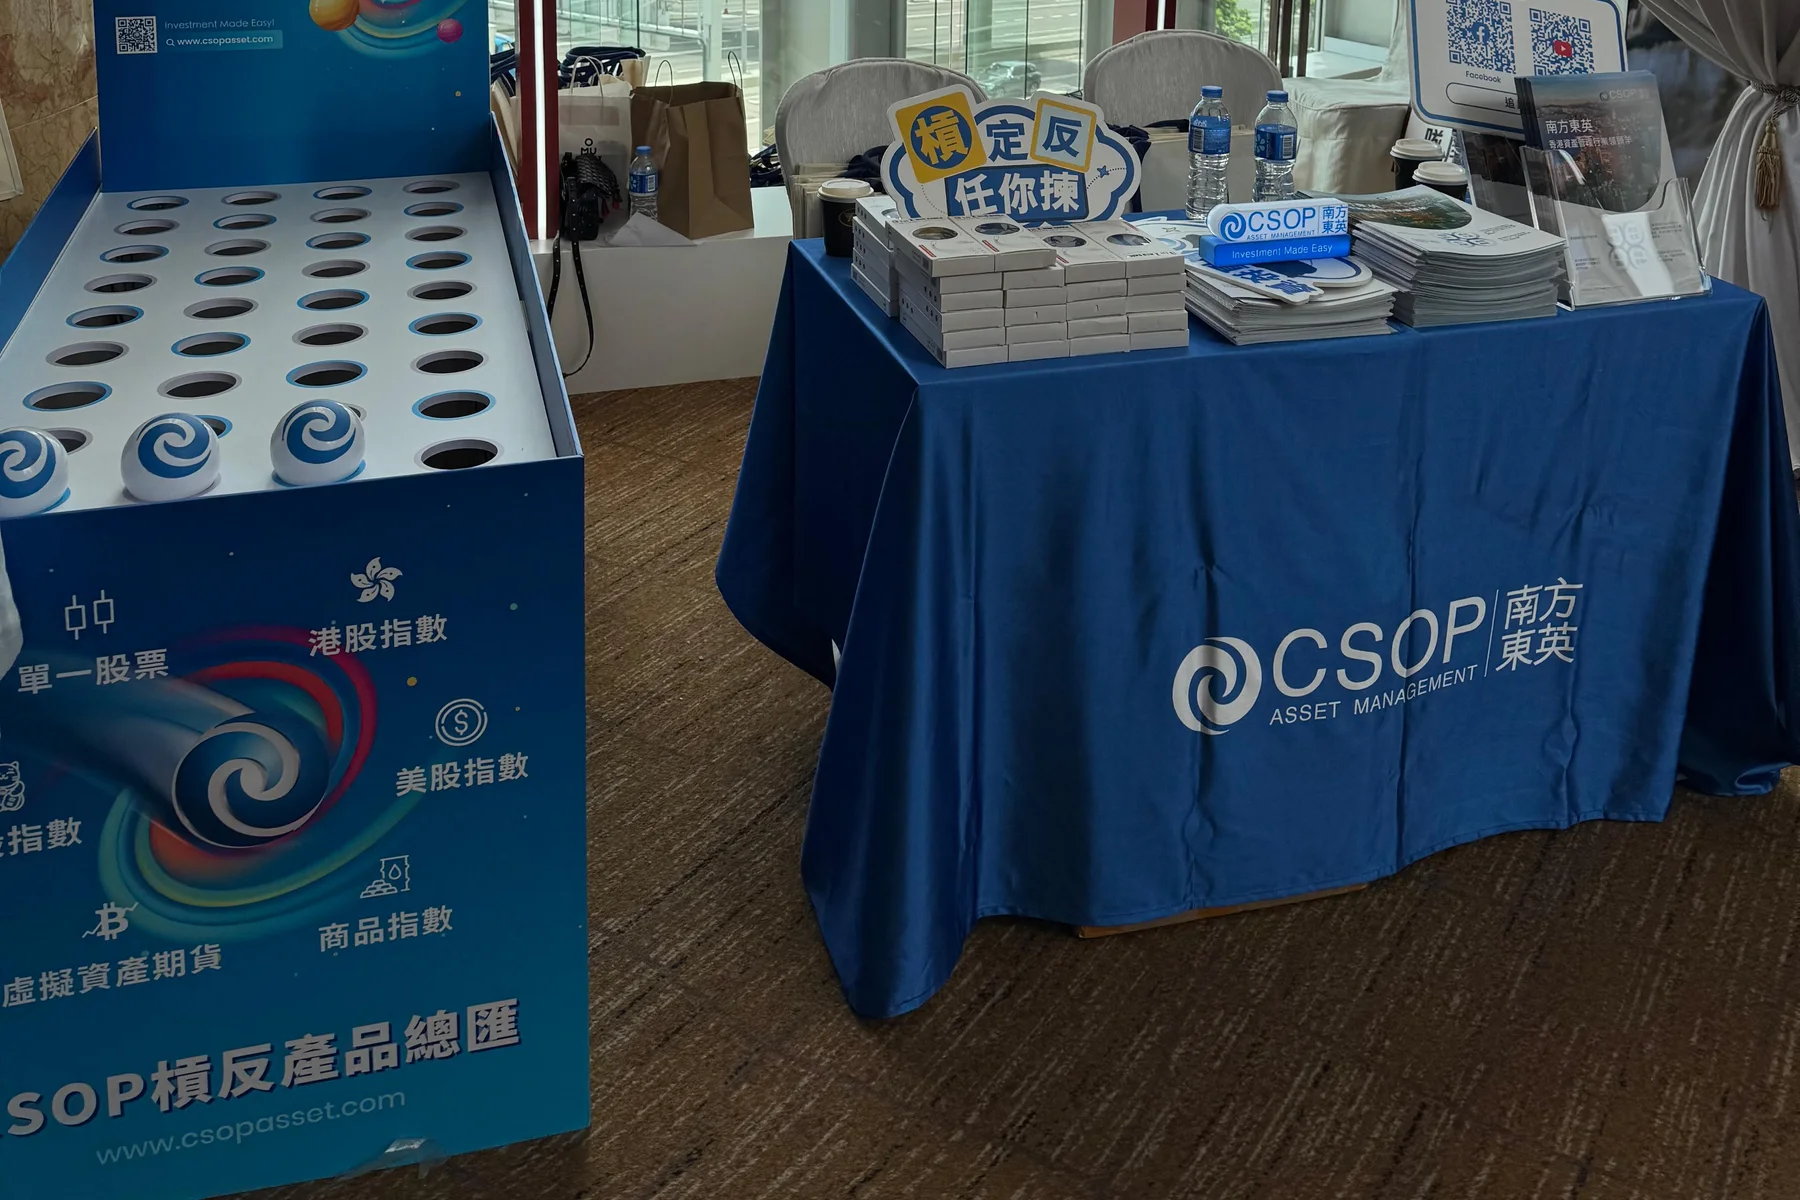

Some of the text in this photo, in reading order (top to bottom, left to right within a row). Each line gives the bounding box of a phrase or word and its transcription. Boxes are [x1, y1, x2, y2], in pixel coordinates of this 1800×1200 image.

[164, 20, 218, 30] Investment
[219, 19, 249, 29] Made
[176, 36, 274, 46] www.csopasset.com
[1465, 70, 1502, 84] Facebook
[1609, 89, 1637, 100] CSOP
[1545, 118, 1595, 135] 南方東英
[954, 170, 1080, 217] 任你揀
[1322, 204, 1347, 219] 南方
[1248, 207, 1315, 232] CSOP
[1270, 230, 1316, 239] MANAGEMENT
[1321, 219, 1347, 233] 東英
[1232, 243, 1333, 259] Investment Made Easy
[1504, 577, 1583, 629] 南方
[308, 614, 448, 657] 港股指數
[1273, 596, 1486, 697] CSOP
[1495, 622, 1578, 672] 東英
[18, 648, 169, 694] 單一股票
[1270, 664, 1478, 726] ASSET MANAGEMENT
[395, 752, 529, 798] 美股指數
[0, 816, 82, 858] 指數
[319, 905, 453, 952] 商品指數
[2, 943, 222, 1008] 虛擬資產期貨
[96, 1090, 405, 1166] www.csopasset.com
